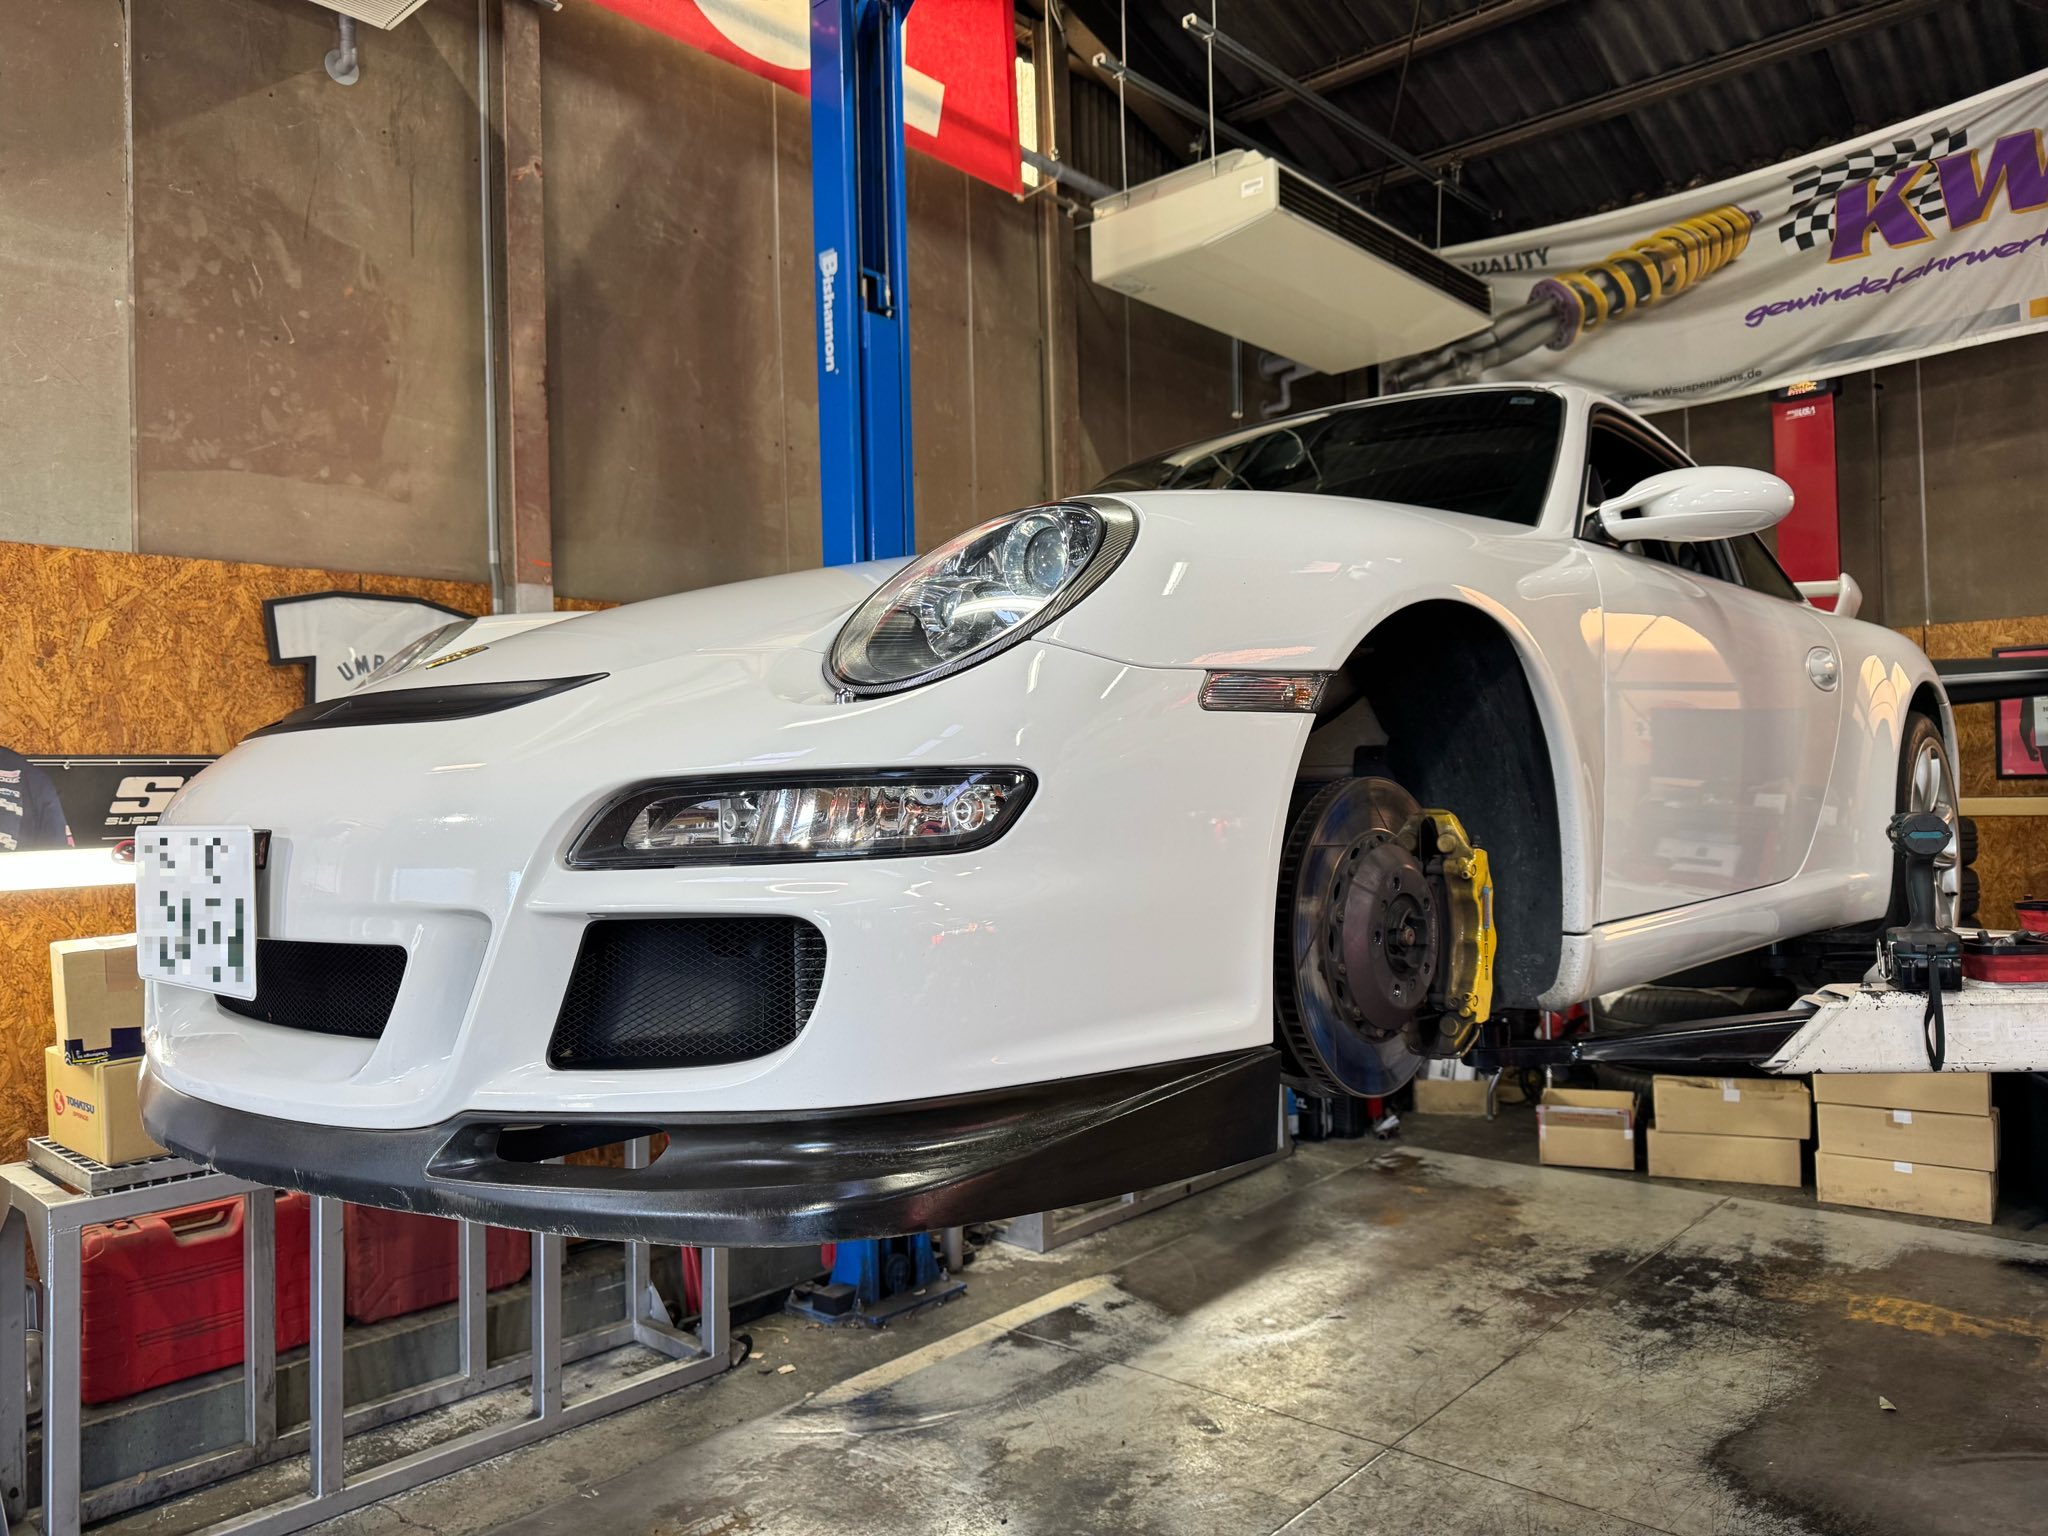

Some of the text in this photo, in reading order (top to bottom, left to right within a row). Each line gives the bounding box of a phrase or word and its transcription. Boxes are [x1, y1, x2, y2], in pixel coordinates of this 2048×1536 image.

[1826, 127, 2048, 264] KW
[1461, 246, 1550, 276] UALITY
[818, 247, 838, 373] Bishamon
[104, 815, 159, 826] SUSP
